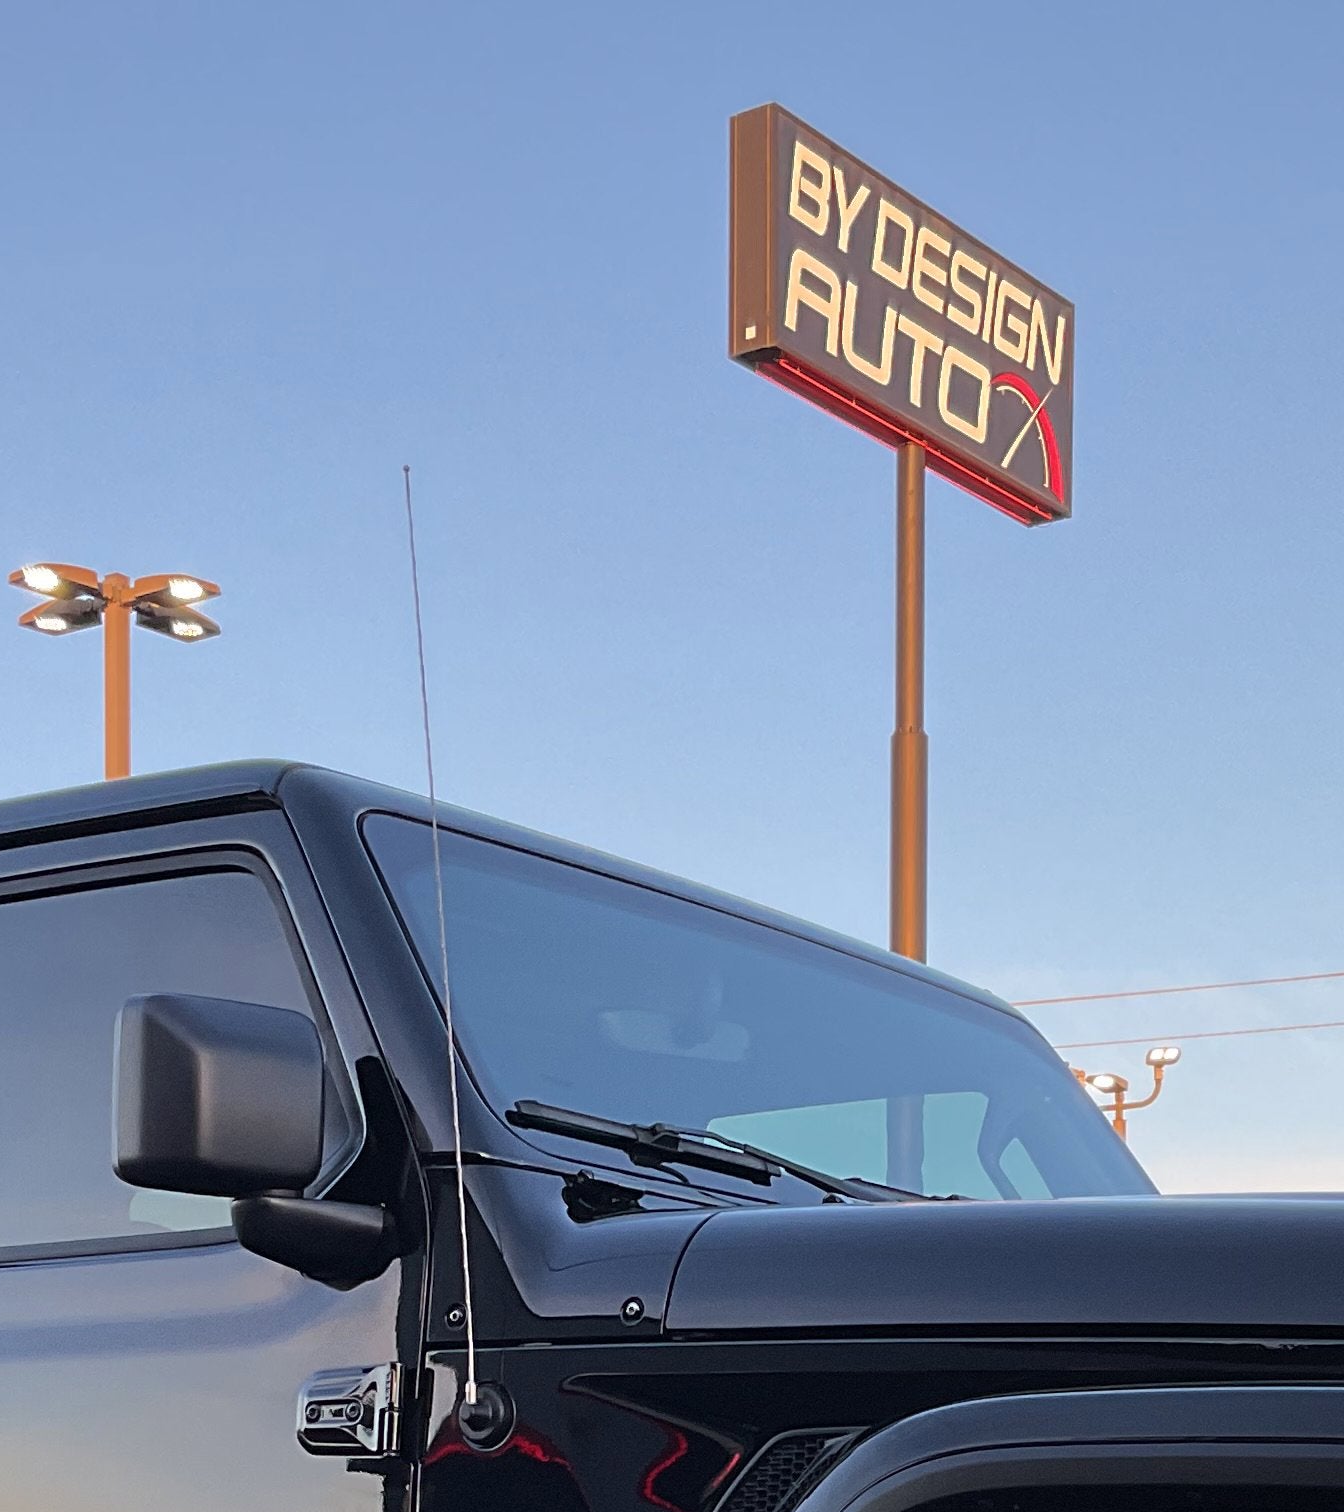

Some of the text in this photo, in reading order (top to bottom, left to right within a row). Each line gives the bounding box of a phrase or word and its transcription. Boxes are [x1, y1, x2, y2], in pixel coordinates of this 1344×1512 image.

[784, 249, 991, 444] AUTO
[789, 140, 1066, 385] BY DESIGN
